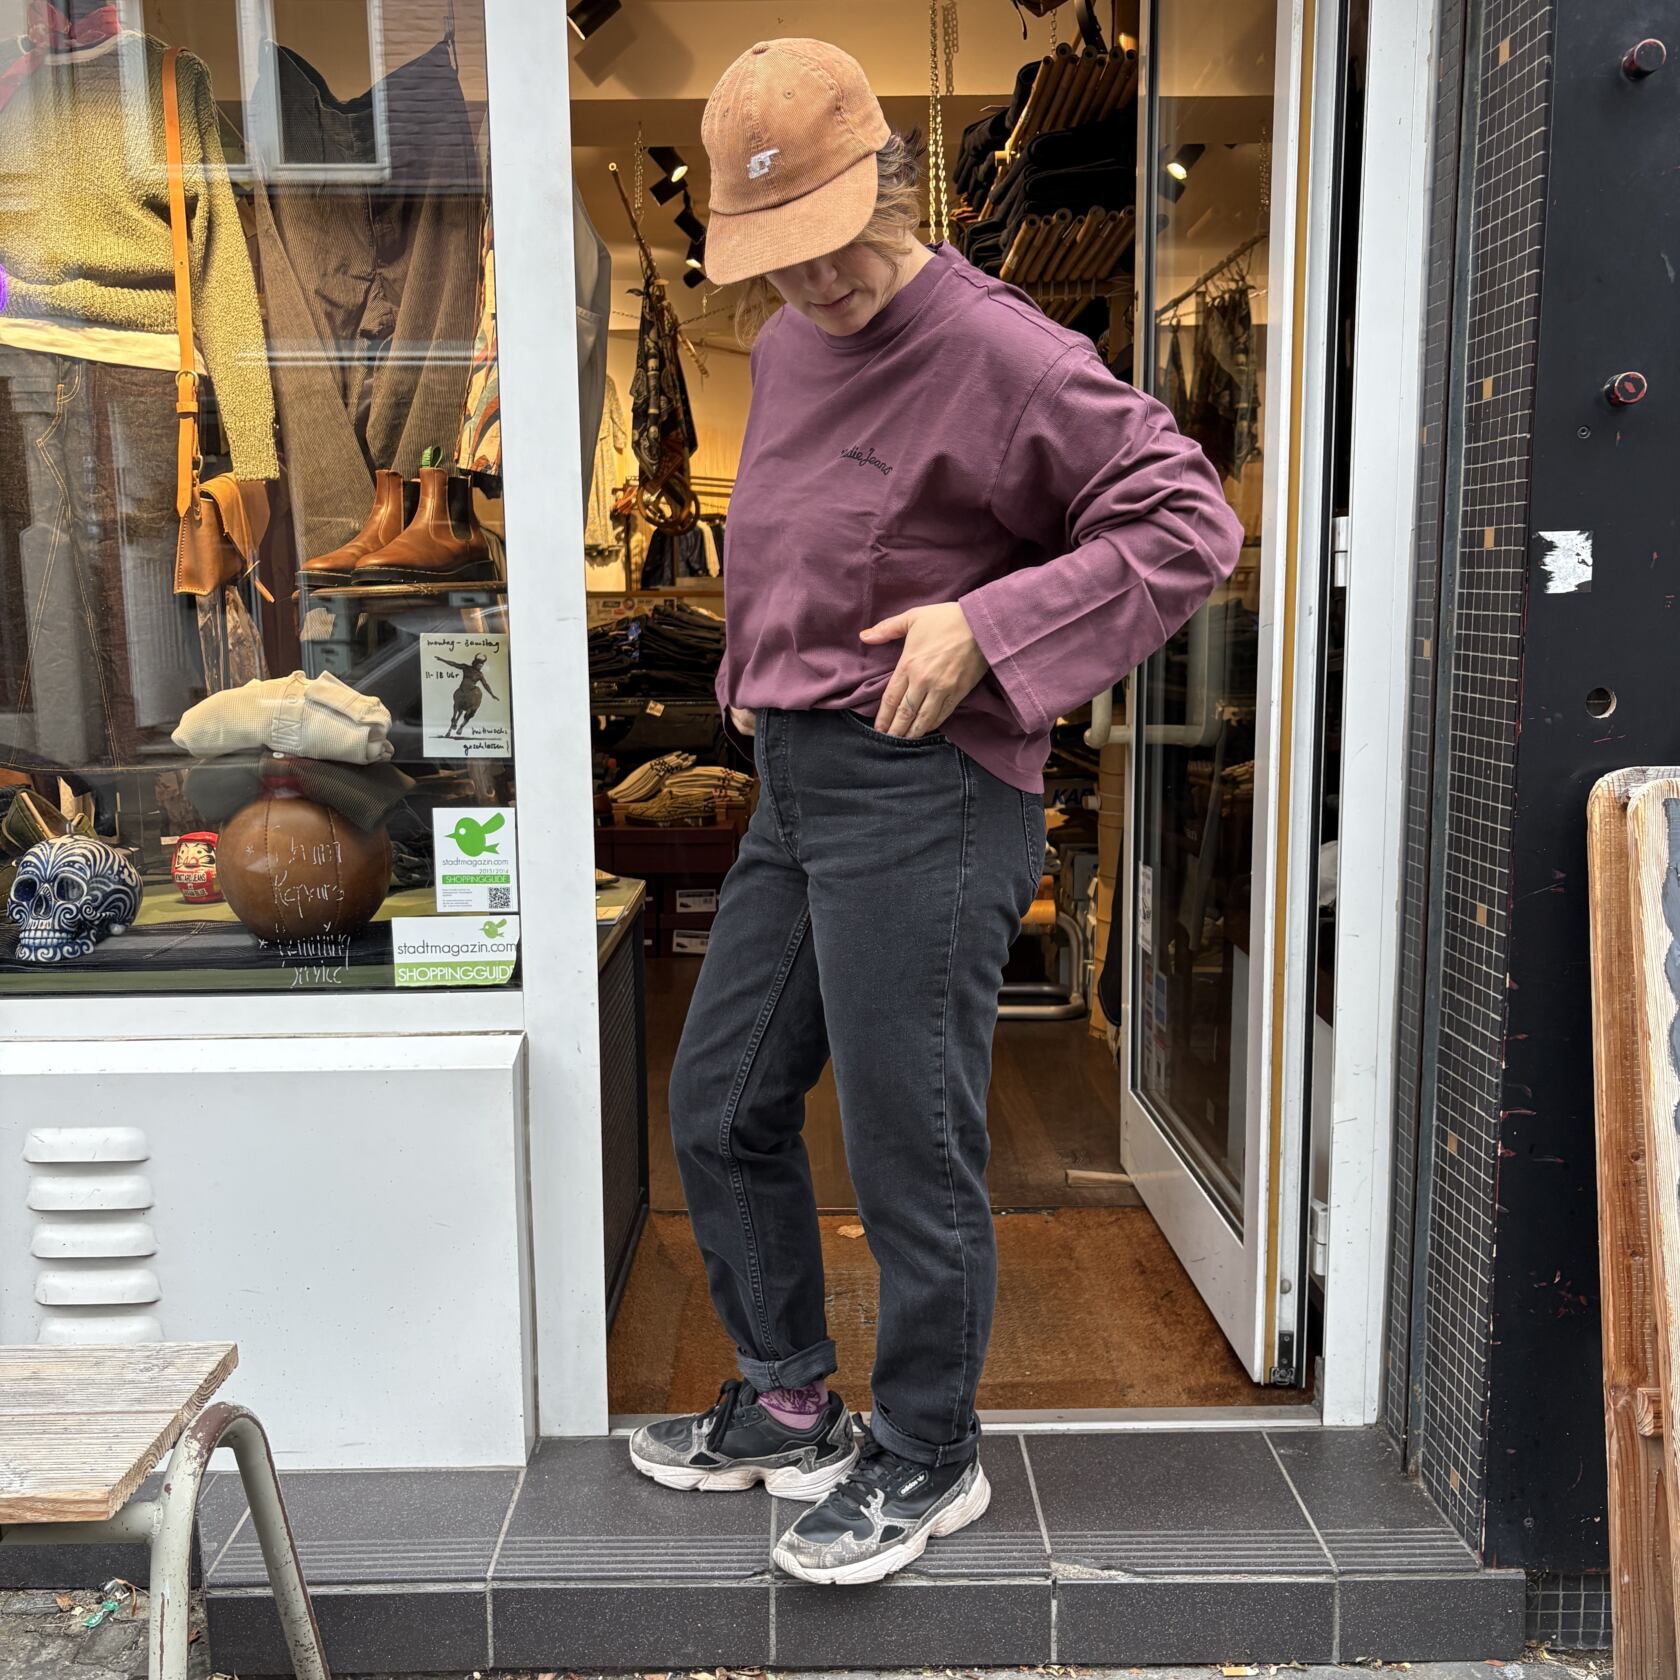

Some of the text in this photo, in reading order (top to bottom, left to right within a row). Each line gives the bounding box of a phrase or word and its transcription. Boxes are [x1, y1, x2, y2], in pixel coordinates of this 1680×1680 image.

[442, 856, 509, 867] stadtmagazin.com
[445, 875, 508, 884] SHOPPINGGUIDE
[397, 939, 517, 957] stadtmagazin.com
[900, 1480, 919, 1495] adidas
